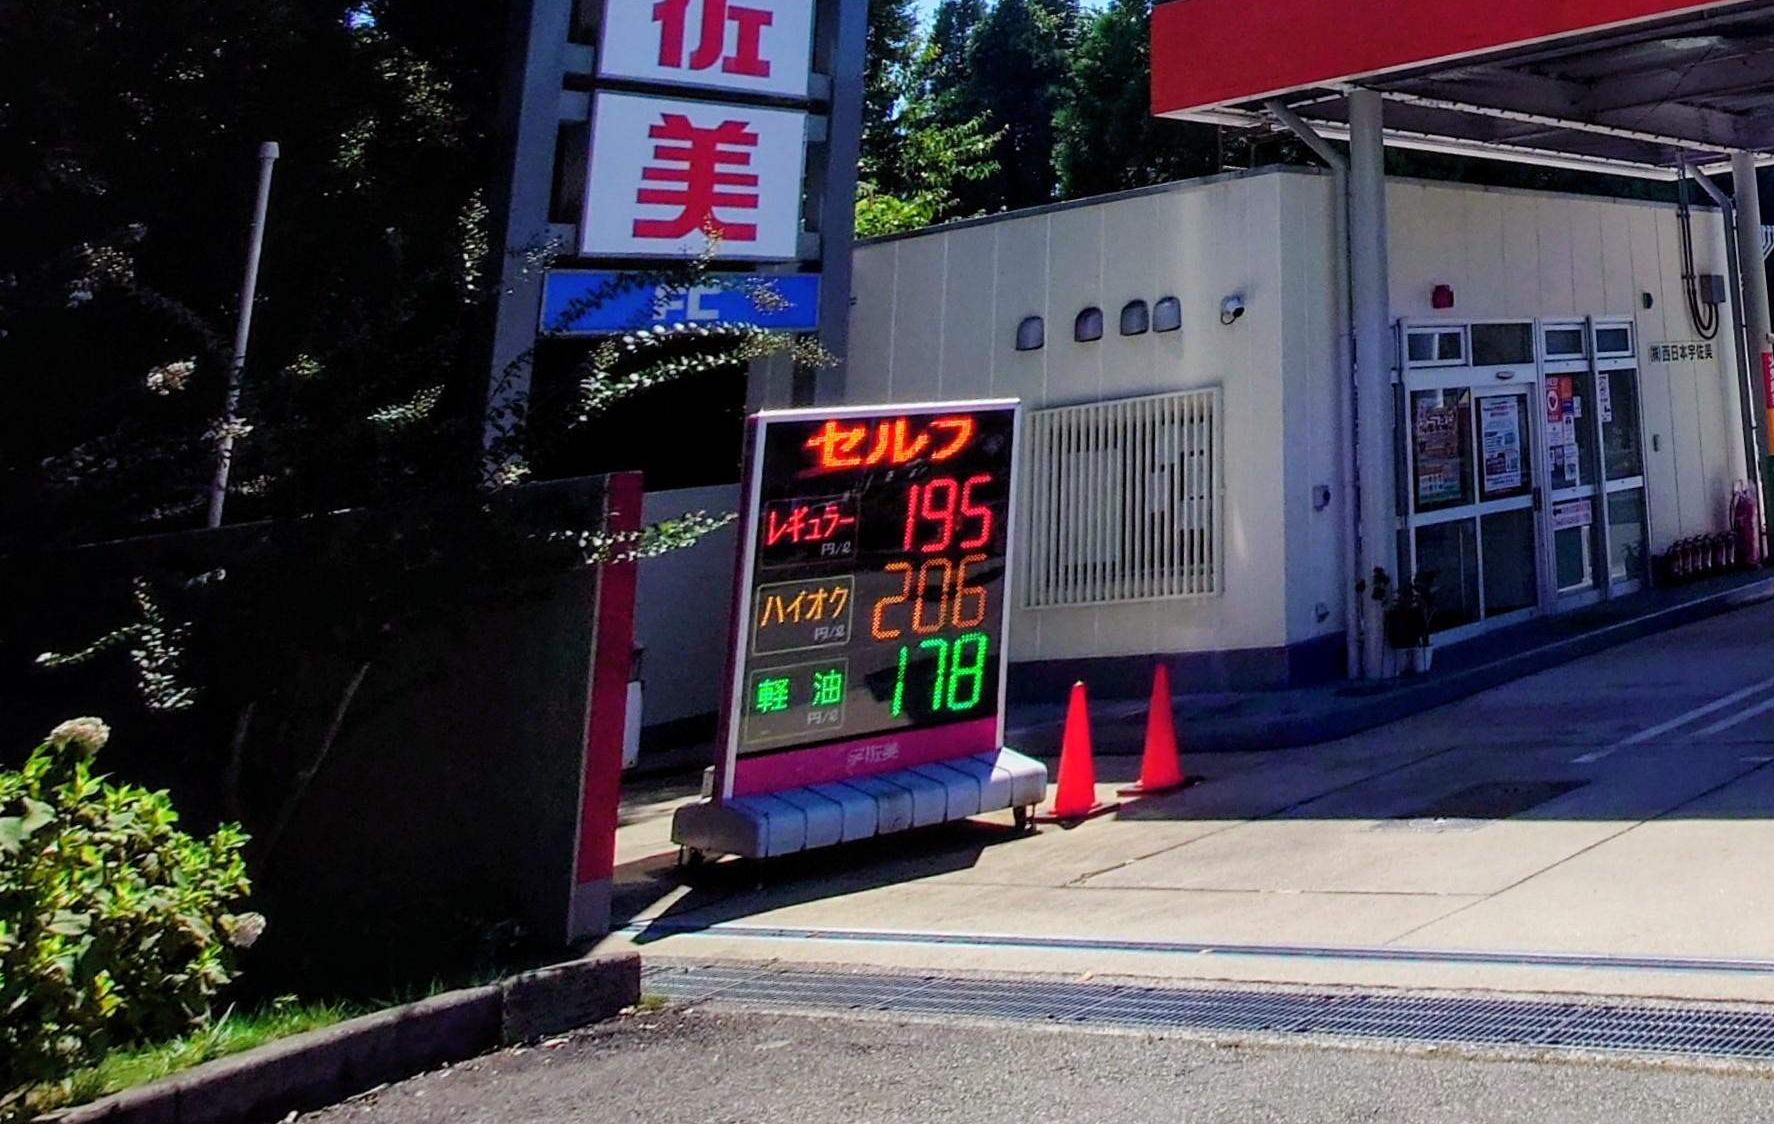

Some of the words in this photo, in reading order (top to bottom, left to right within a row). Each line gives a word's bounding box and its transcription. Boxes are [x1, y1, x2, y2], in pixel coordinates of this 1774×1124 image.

[805, 415, 975, 469] セルフ
[766, 505, 855, 547] レギュラー
[903, 474, 993, 553] 195
[760, 585, 849, 628] ハイオク
[872, 554, 988, 641] 206
[889, 633, 987, 718] 178
